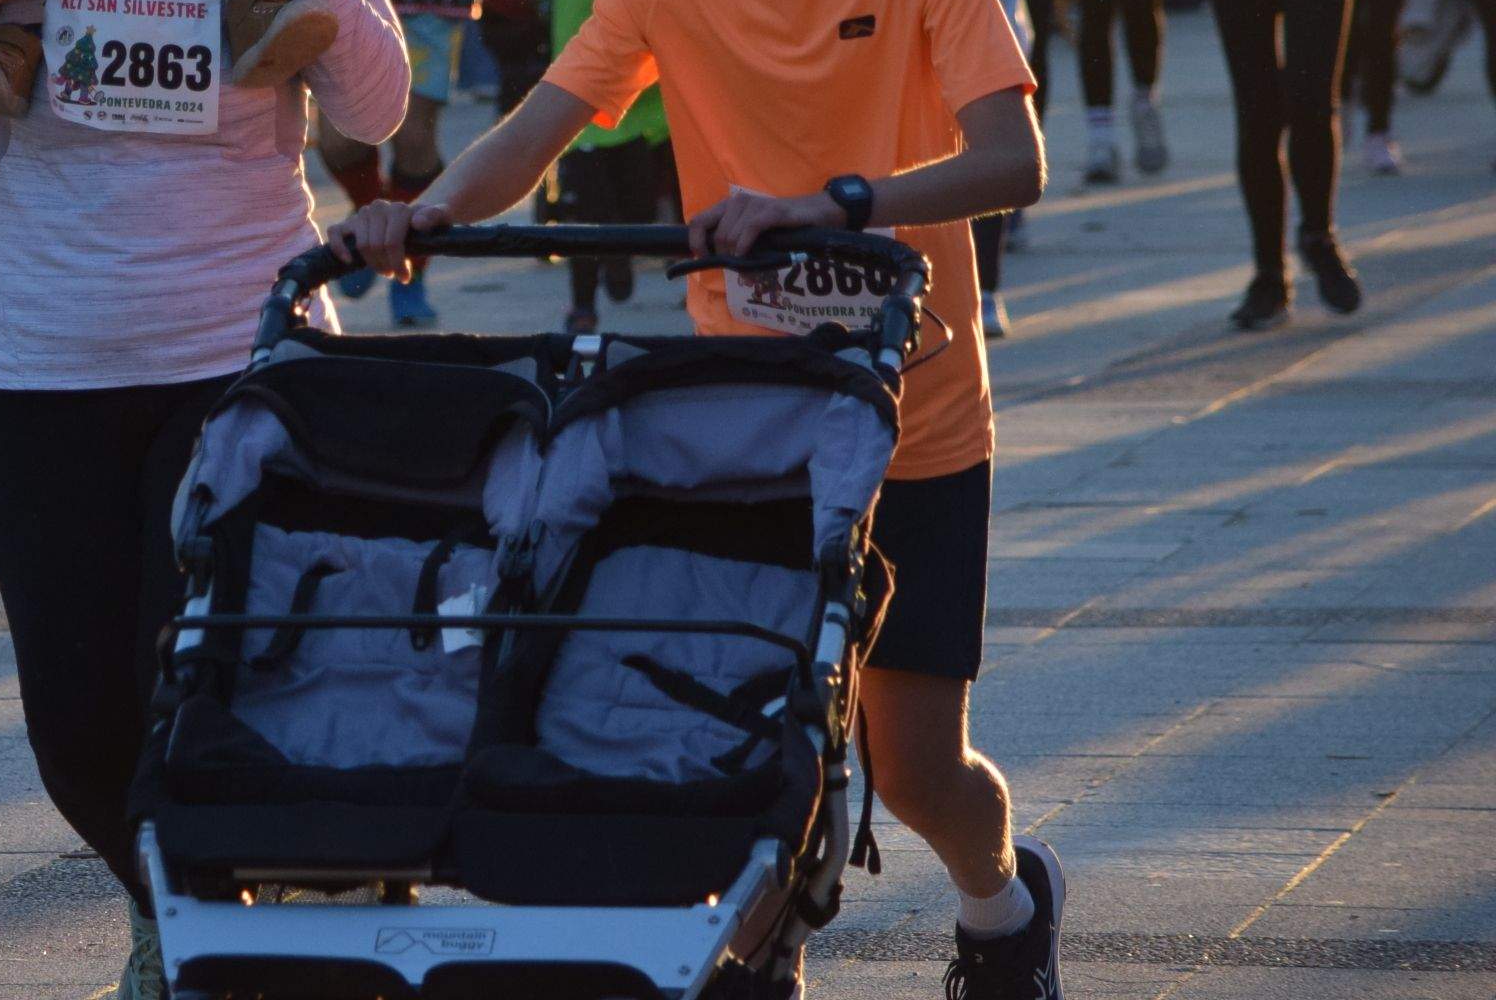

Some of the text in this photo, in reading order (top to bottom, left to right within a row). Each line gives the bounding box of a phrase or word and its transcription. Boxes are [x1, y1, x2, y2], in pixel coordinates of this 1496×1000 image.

[101, 40, 212, 92] 2863
[99, 97, 203, 113] PONTEVEDRA 2024
[788, 305, 854, 318] PONTEVEDRA
[422, 930, 487, 940] mountain
[440, 940, 485, 950] buggy
